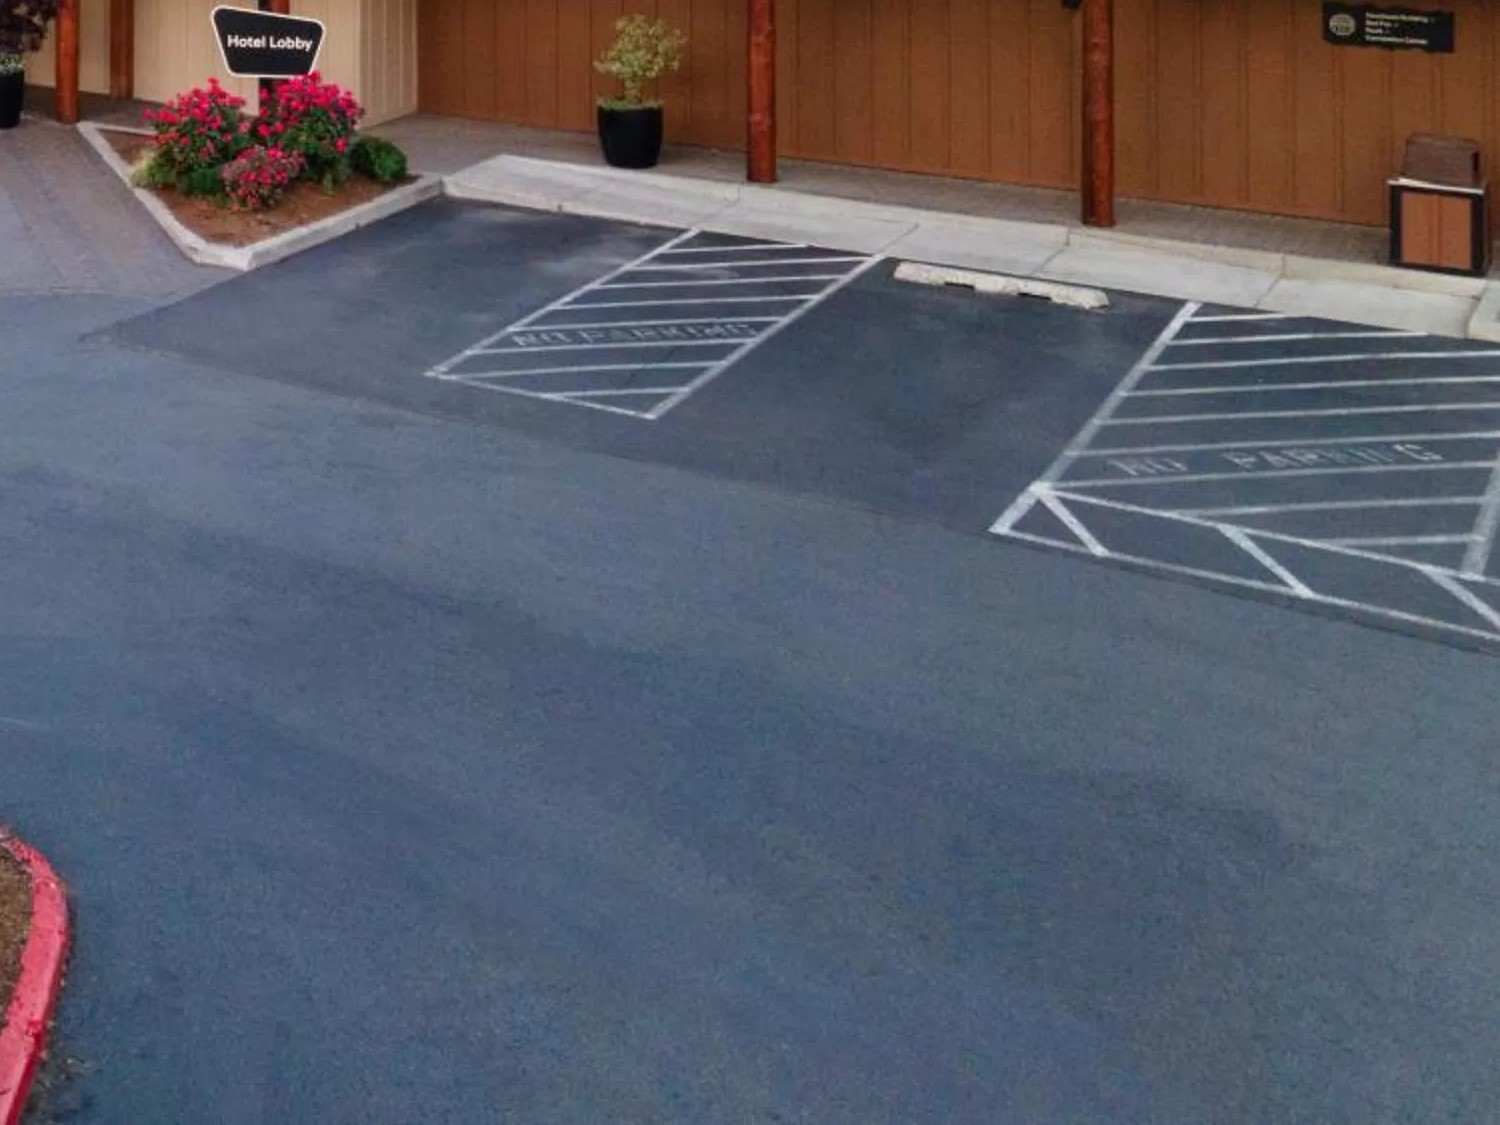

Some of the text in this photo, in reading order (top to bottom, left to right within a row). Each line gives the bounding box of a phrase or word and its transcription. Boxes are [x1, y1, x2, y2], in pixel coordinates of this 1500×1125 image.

[227, 35, 313, 52] Hotel Lobby
[1219, 443, 1444, 469] PARKING
